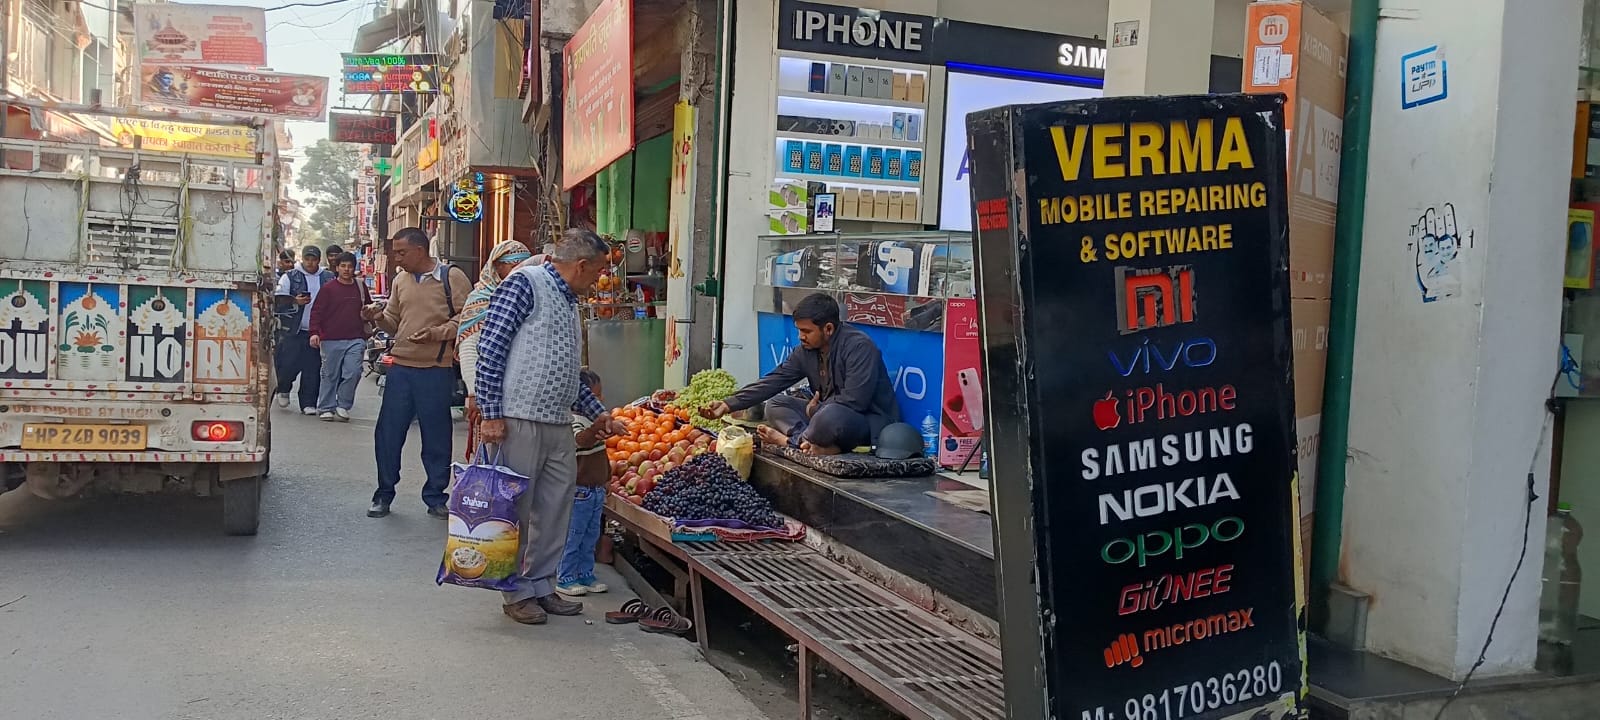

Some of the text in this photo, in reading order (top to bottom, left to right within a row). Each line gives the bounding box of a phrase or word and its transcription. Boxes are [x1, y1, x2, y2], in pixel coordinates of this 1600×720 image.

[793, 10, 923, 51] IPHONE
[1050, 116, 1255, 182] VERMA
[1039, 191, 1132, 225] MOBILE
[1139, 181, 1267, 217] REPAIRING
[1079, 223, 1234, 264] & SOFTWARE
[1108, 336, 1217, 378] vivo
[1127, 382, 1237, 424] iPhone
[35, 428, 58, 443] HP
[98, 429, 141, 445] 9039
[1081, 422, 1254, 481] SAMSUNG
[1098, 472, 1241, 525] NOKIA
[1100, 516, 1245, 568] oppo
[1144, 607, 1255, 653] micromax
[1124, 659, 1283, 720] 9817036280
